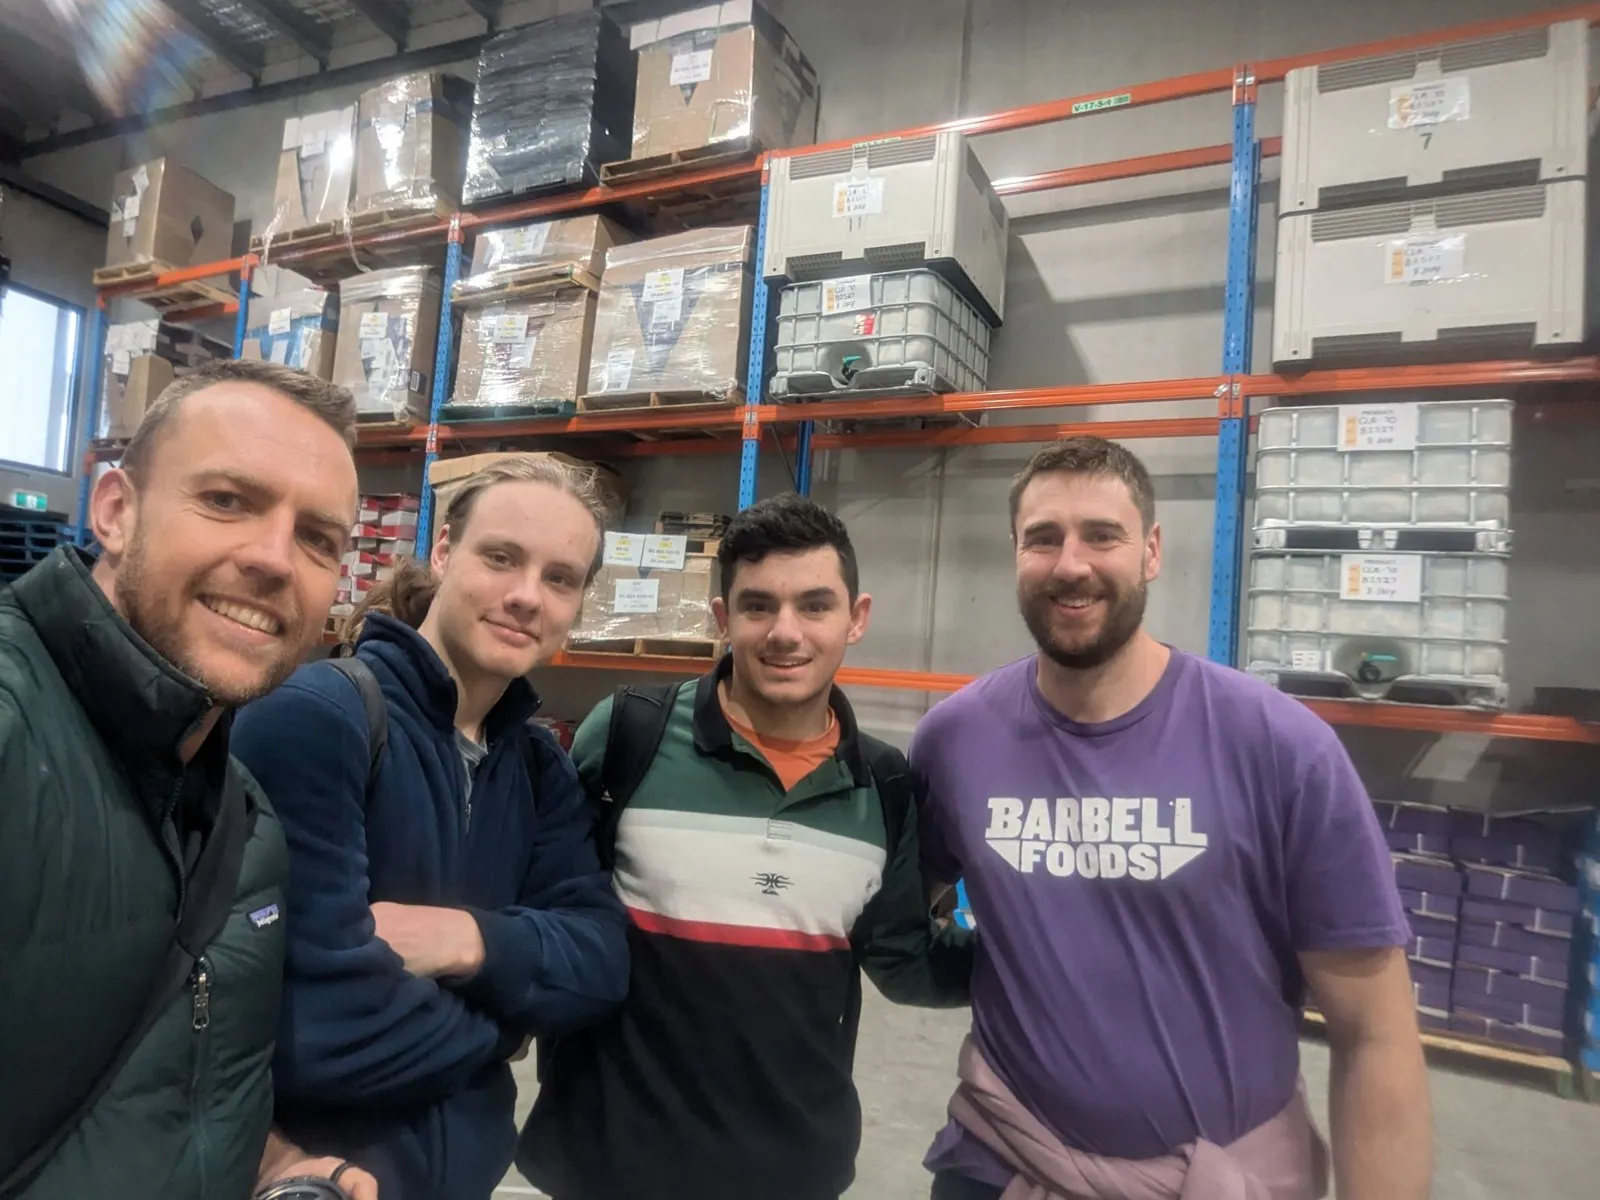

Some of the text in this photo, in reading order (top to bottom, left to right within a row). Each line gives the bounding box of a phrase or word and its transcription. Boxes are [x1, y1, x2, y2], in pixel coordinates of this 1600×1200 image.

[1420, 132, 1432, 150] 7
[985, 797, 1208, 846] BARBELL
[1020, 842, 1158, 881] FOODS
